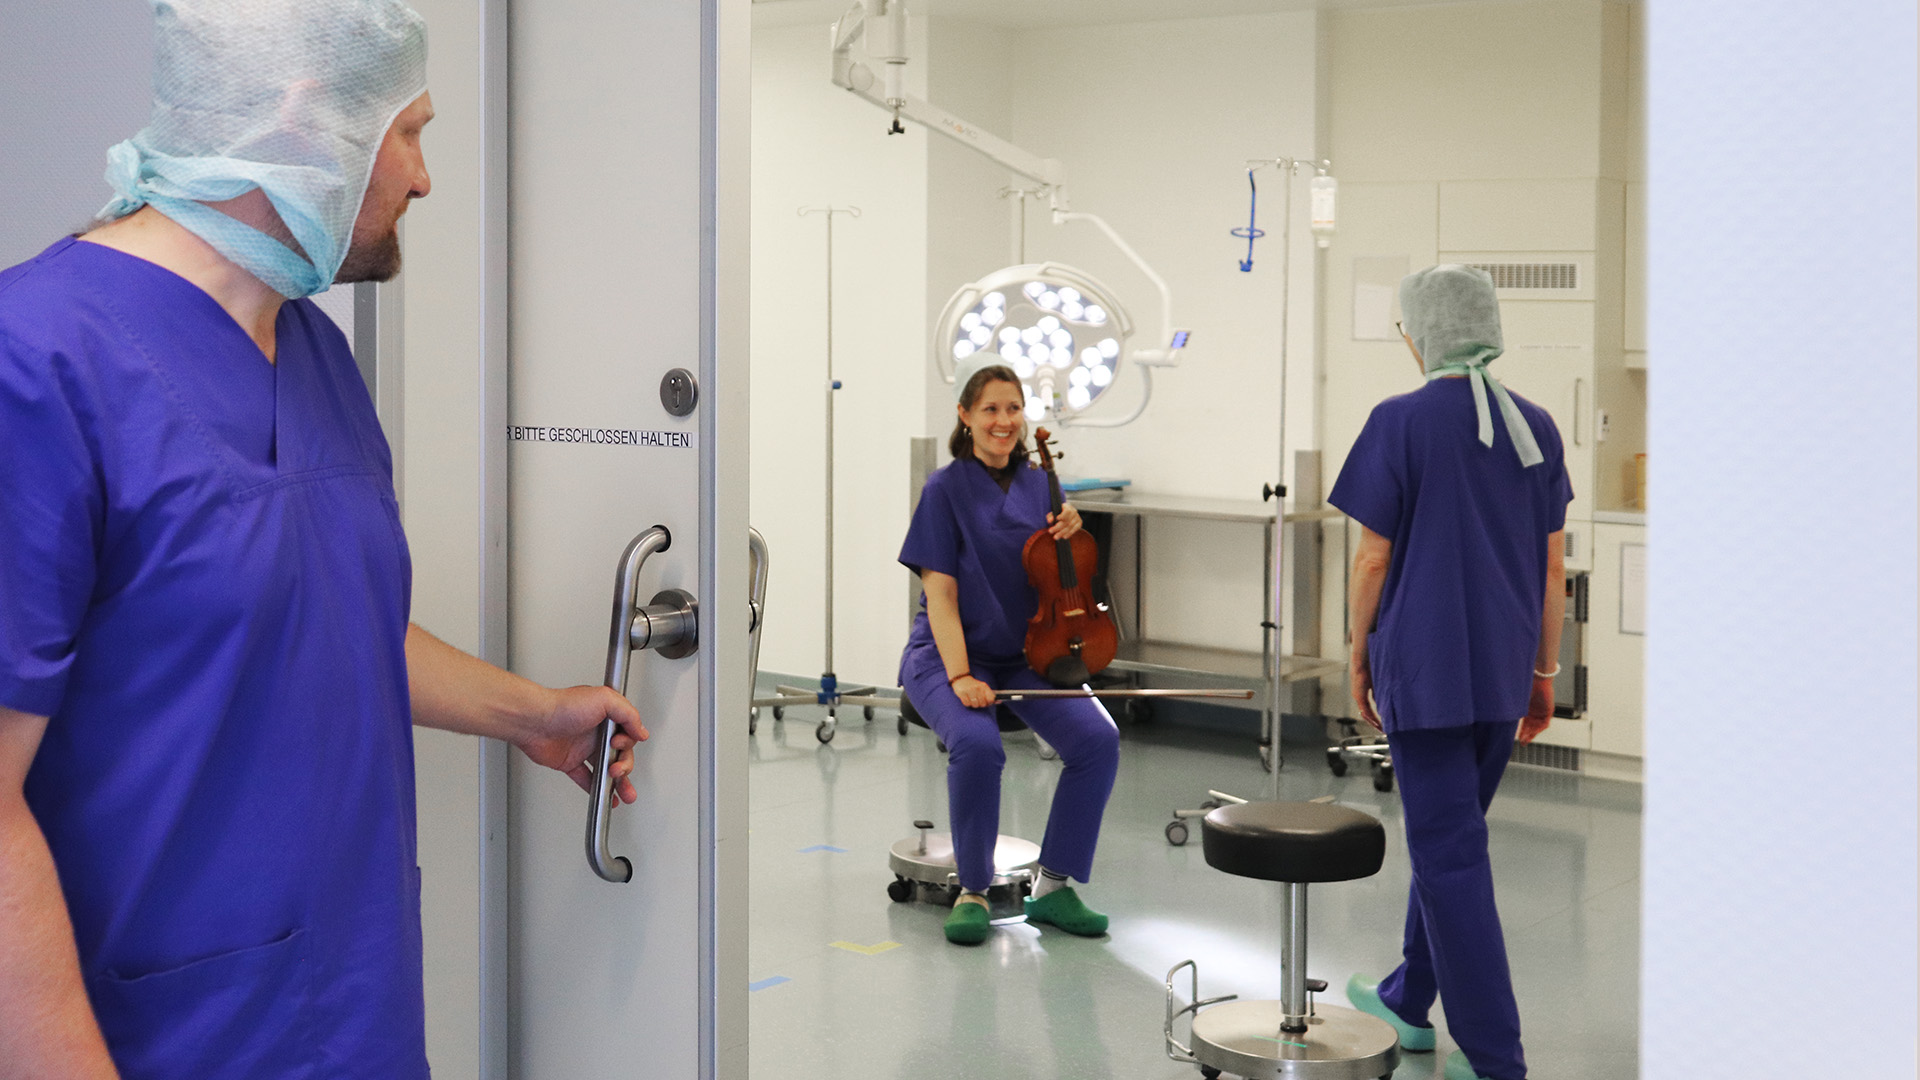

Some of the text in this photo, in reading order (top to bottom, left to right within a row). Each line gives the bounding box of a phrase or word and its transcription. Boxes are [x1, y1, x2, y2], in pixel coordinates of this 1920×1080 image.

[514, 426, 546, 441] BITTE
[548, 427, 637, 445] GESCHLOSSEN
[641, 431, 689, 447] HALTEN
